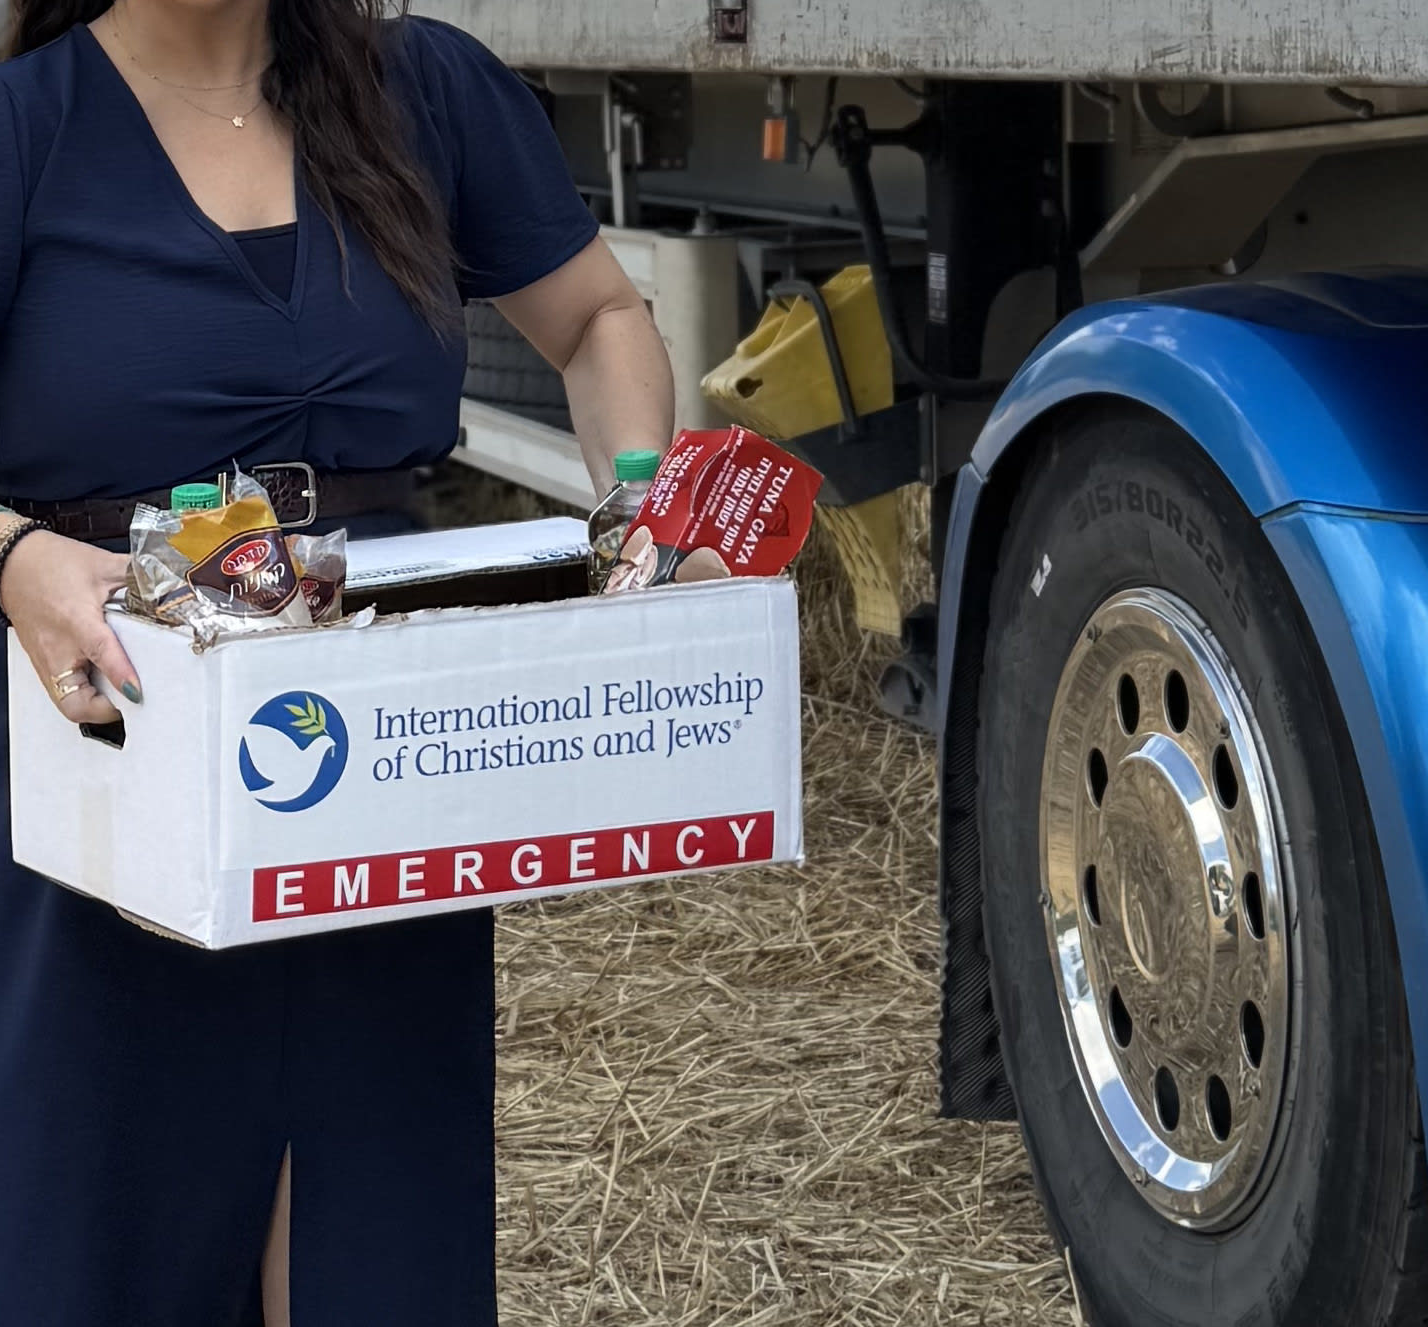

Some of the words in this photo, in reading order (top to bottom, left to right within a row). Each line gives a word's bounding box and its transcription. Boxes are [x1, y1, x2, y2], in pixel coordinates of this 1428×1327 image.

[759, 466, 793, 514] TUNA
[735, 518, 765, 565] GAYA
[373, 686, 591, 741] International
[602, 671, 764, 717] Fellowship
[373, 746, 408, 783] of
[415, 736, 584, 778] Christians
[593, 720, 655, 759] and
[276, 818, 757, 914] EMERGENCY
